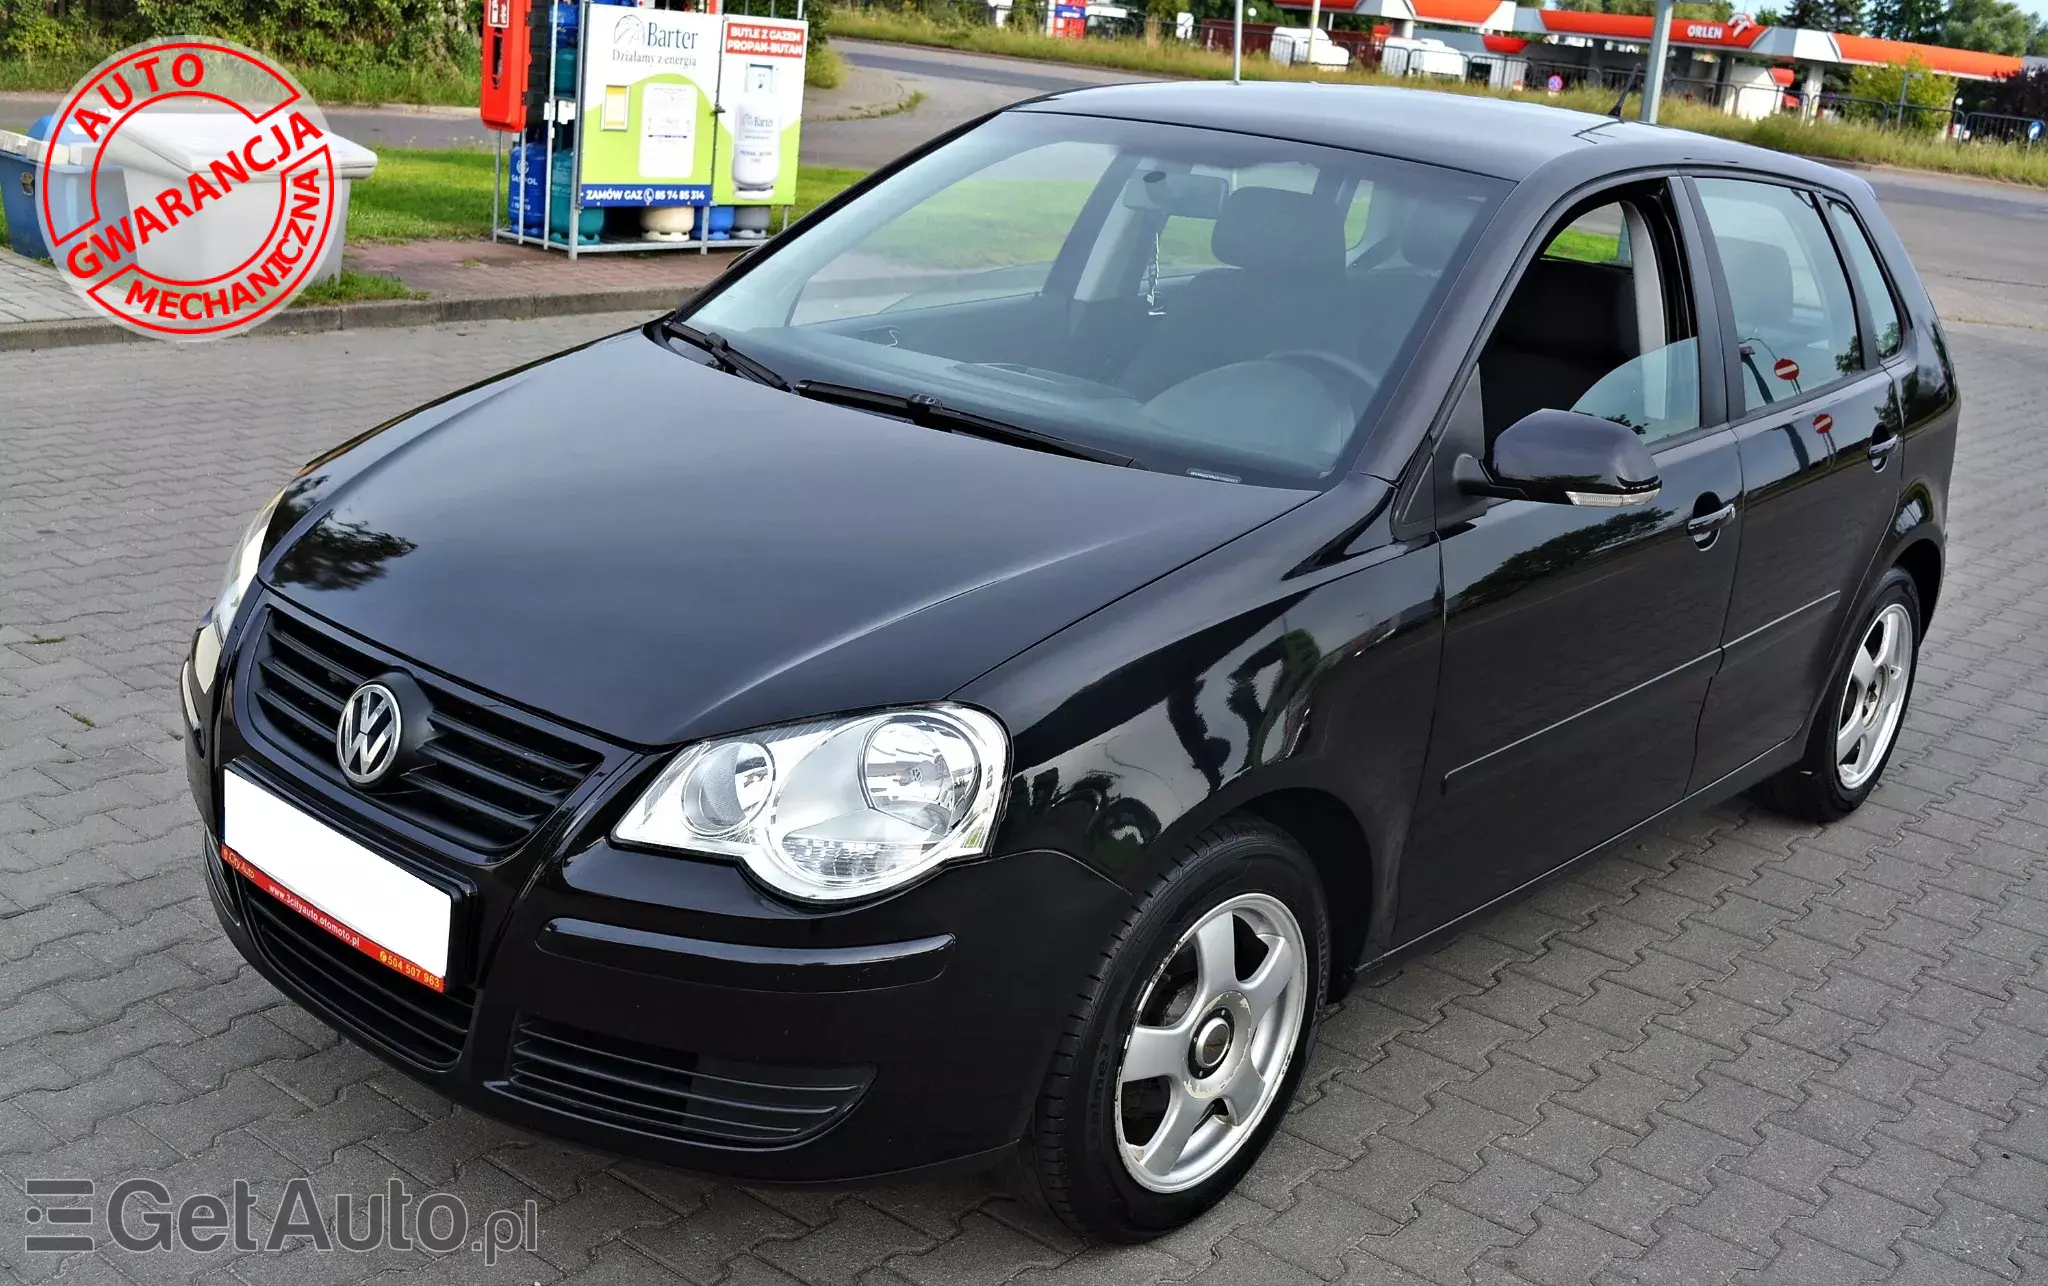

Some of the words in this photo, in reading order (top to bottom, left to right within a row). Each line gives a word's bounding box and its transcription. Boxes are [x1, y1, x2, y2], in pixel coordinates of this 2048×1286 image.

[647, 21, 699, 49] Barter
[730, 26, 760, 39] BUTLE
[761, 29, 768, 40] Z
[769, 29, 802, 42] GAZEM
[1687, 25, 1723, 39] ORLEN
[727, 39, 803, 55] PROPAN-BUTAN
[585, 187, 623, 200] ZAMÓW
[624, 190, 643, 200] GAZ
[655, 190, 666, 200] 85
[667, 190, 678, 200] 74
[679, 190, 690, 200] 85
[690, 190, 706, 200] 314
[268, 884, 360, 946] www.3cityauto.otomoto.pl
[387, 955, 403, 970] 504
[405, 964, 421, 978] 507
[423, 972, 440, 988] 963
